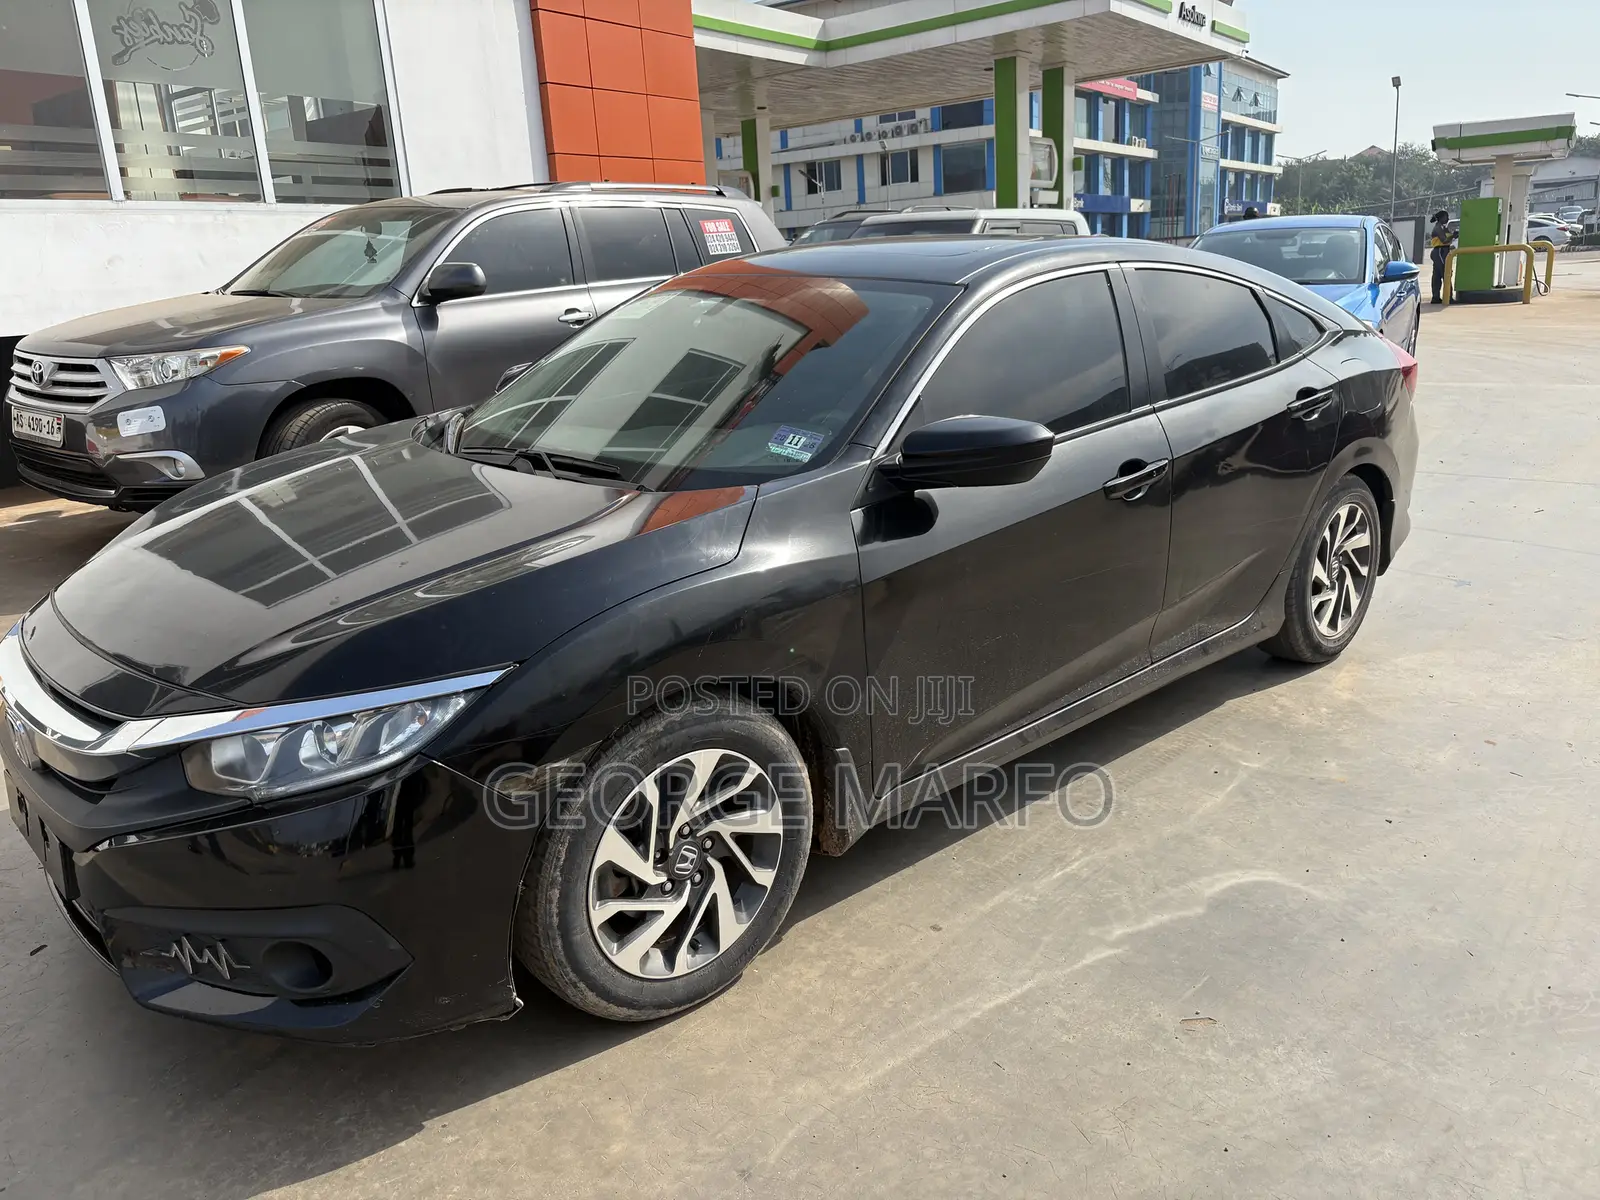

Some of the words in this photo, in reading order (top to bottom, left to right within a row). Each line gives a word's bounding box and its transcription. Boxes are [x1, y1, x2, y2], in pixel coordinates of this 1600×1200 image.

[1179, 2, 1206, 27] Asokwa
[704, 222, 717, 233] FOR
[715, 221, 730, 232] SALE
[787, 435, 802, 447] 11
